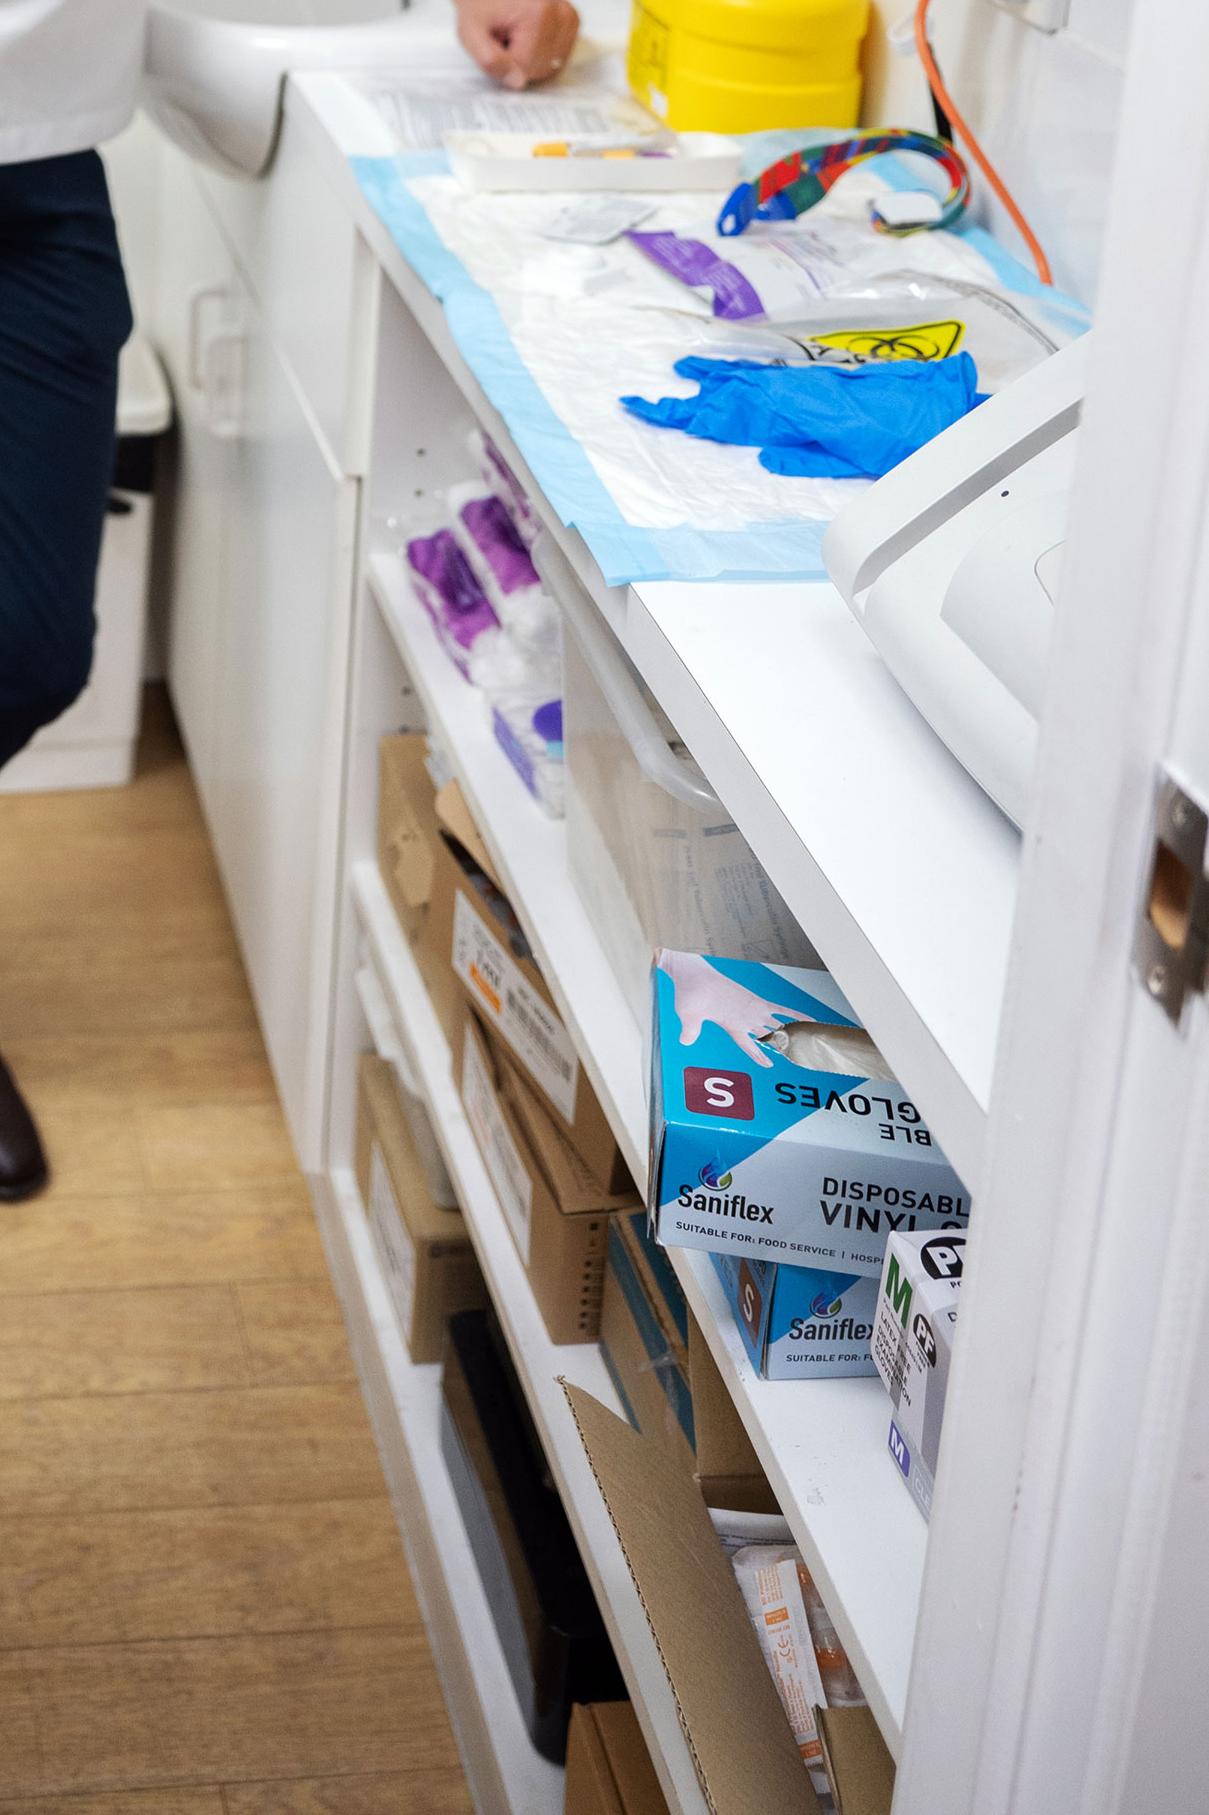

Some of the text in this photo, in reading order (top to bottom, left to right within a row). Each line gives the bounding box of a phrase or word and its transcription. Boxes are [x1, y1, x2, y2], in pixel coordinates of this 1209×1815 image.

[704, 1077, 734, 1108] S
[775, 1082, 921, 1124] GLOVES
[677, 1183, 774, 1225] Saniflex
[676, 1221, 728, 1238] SUITABLE
[731, 1232, 756, 1243] FOR:
[758, 1237, 787, 1249] FOOD
[790, 1243, 836, 1257] SERVICE
[743, 1283, 755, 1322] S
[886, 1252, 913, 1330] M
[880, 1310, 897, 1342] LATEX
[786, 1354, 835, 1362] SUITABLE
[891, 1427, 904, 1465] M
